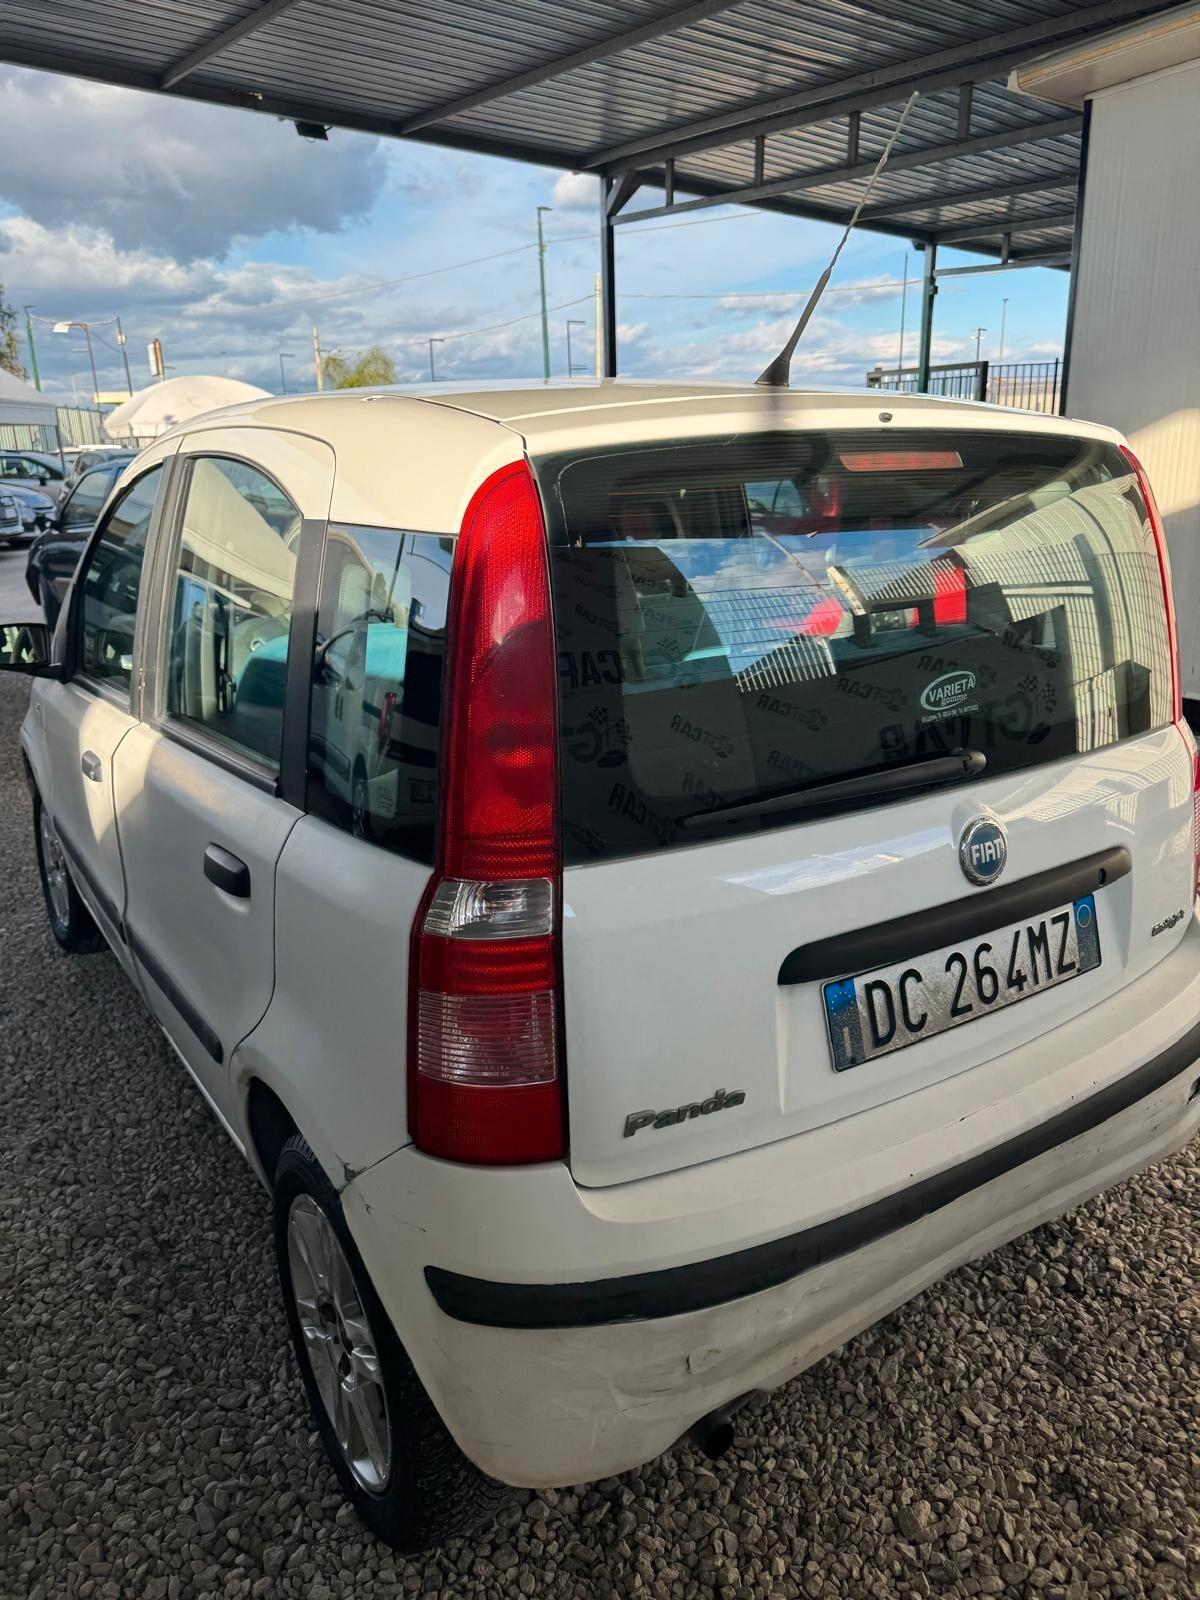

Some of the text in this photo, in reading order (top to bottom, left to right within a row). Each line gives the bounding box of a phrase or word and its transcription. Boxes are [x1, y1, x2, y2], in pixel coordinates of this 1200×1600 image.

[928, 674, 975, 702] VARIETÀ
[971, 838, 1001, 866] FIAT
[865, 968, 928, 1048] DC
[623, 1088, 746, 1138] Panda
